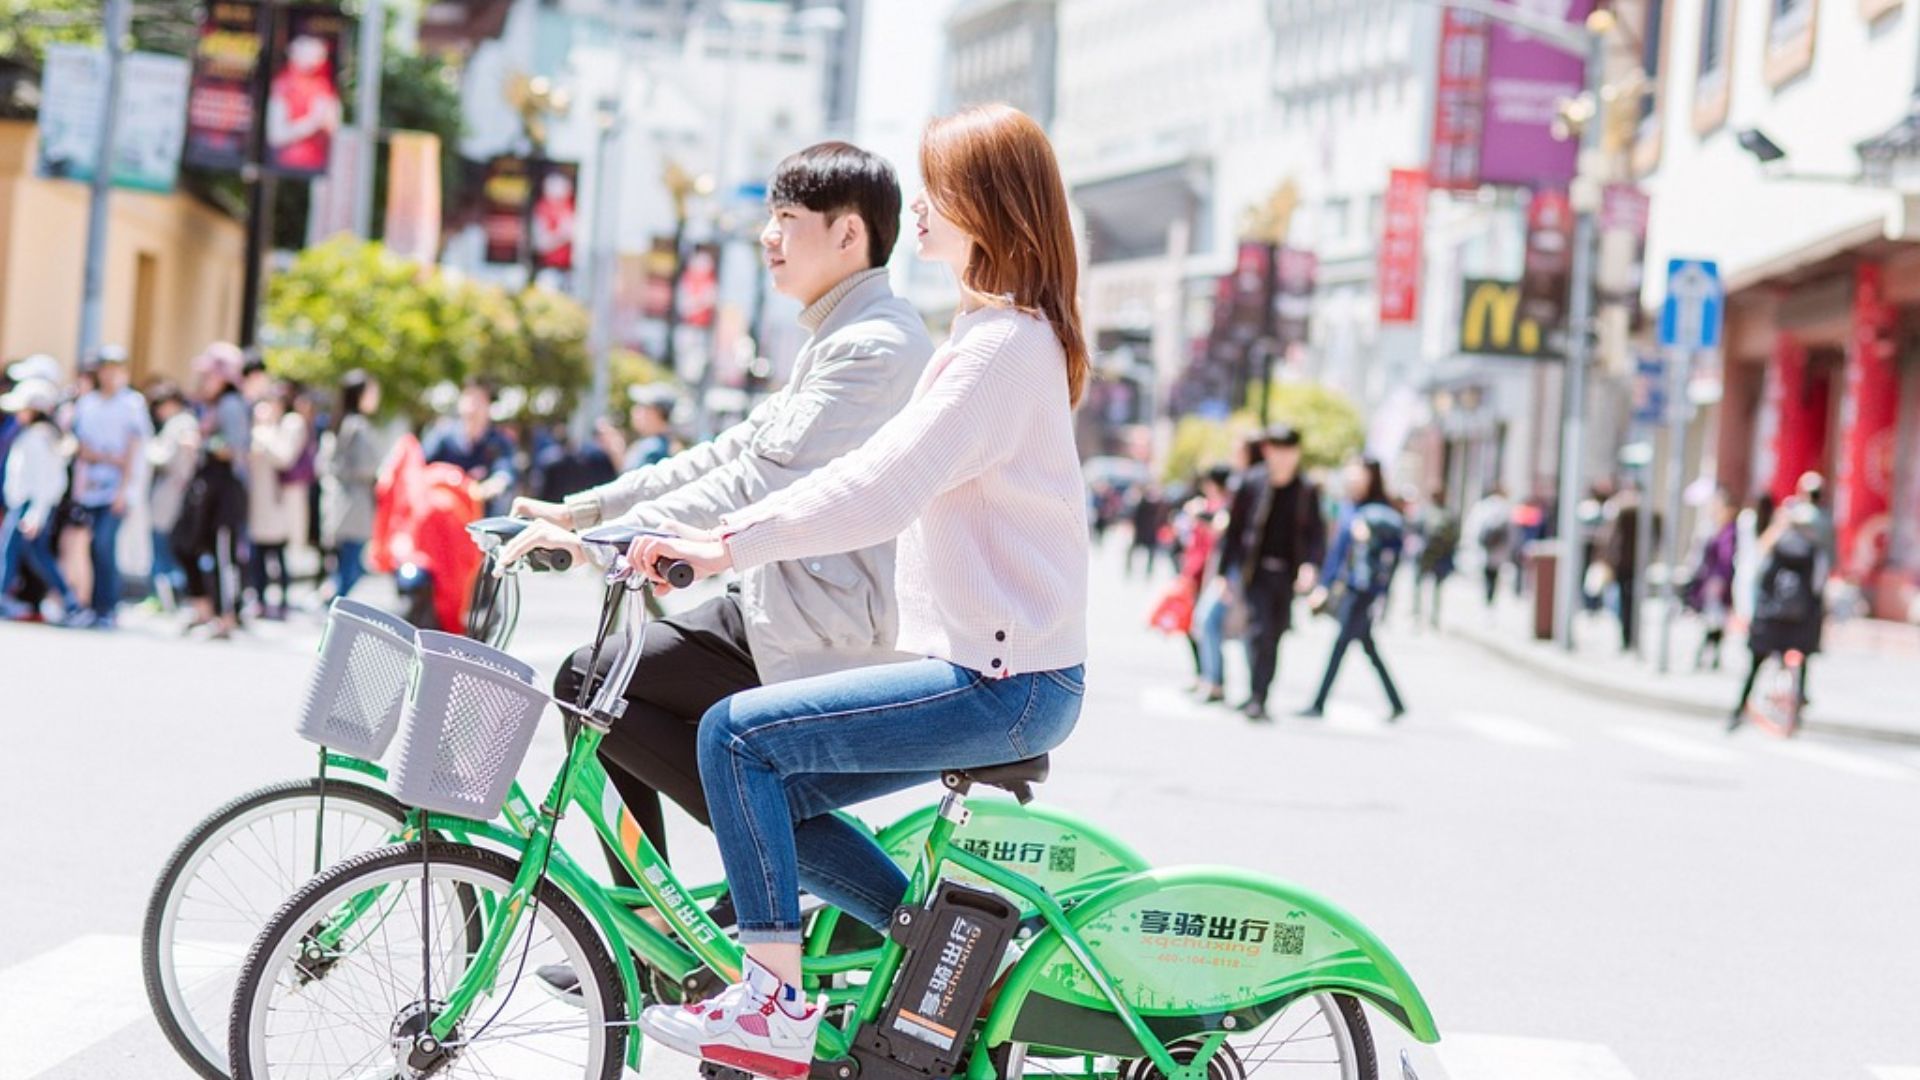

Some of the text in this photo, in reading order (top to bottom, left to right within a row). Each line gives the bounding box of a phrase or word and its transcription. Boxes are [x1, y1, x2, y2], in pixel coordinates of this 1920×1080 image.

[952, 838, 1045, 863] 骑出行
[1140, 909, 1270, 943] 享骑出行
[1140, 935, 1262, 957] xqchuxing
[938, 926, 981, 1017] xqchuxing
